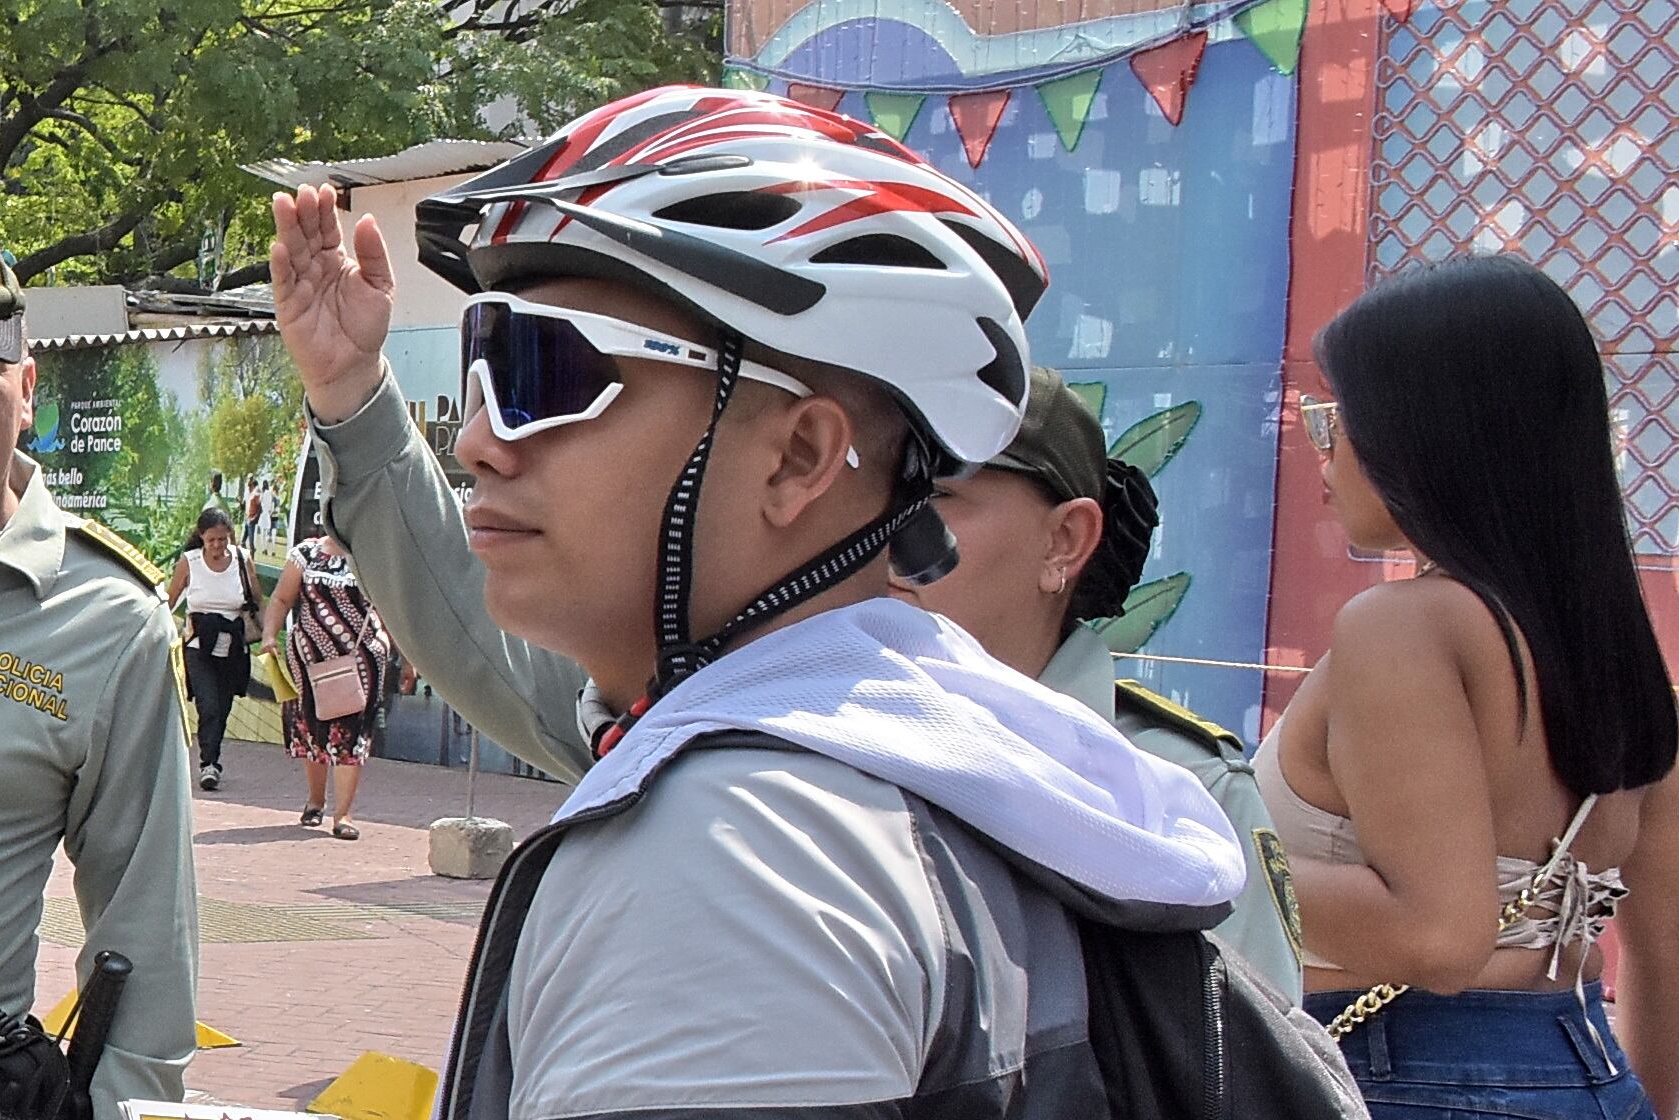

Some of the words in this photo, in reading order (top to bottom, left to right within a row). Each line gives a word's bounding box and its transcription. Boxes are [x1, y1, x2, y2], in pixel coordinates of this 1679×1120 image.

[70, 409, 122, 433] Corazón
[70, 437, 85, 453] de
[87, 435, 122, 453] Pance
[58, 467, 83, 485] bello
